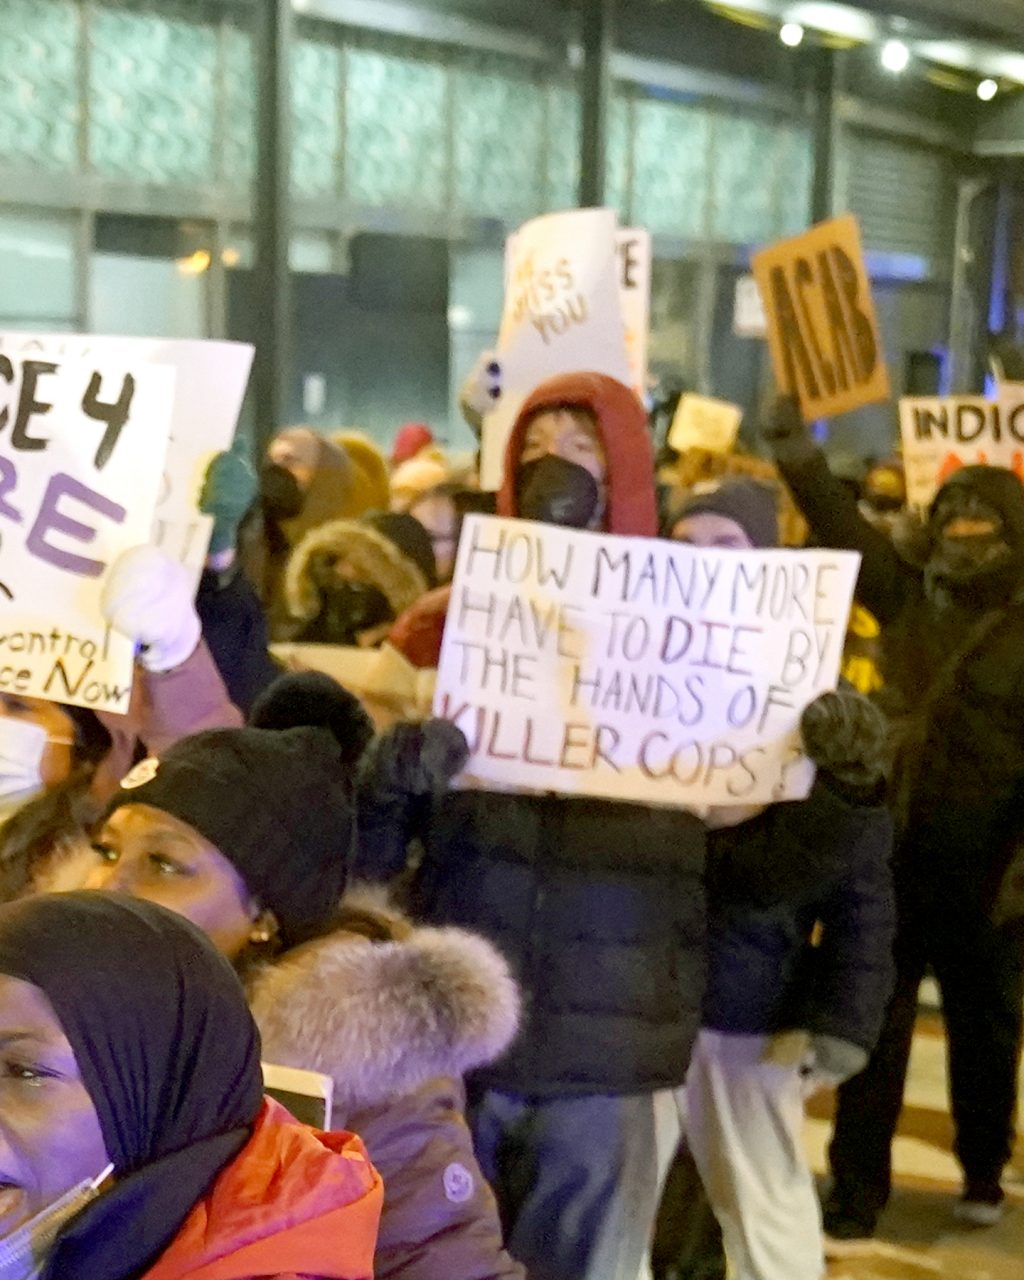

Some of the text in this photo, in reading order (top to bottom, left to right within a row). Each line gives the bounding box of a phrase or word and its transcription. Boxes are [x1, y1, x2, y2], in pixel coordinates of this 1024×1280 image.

[81, 371, 136, 470] 4
[465, 524, 840, 626] HOW MANY MORE
[44, 656, 129, 703] Now
[457, 585, 832, 688] HAVE TO DIE BY
[440, 693, 621, 774] KILLER
[450, 639, 795, 734] THE HANDS OF
